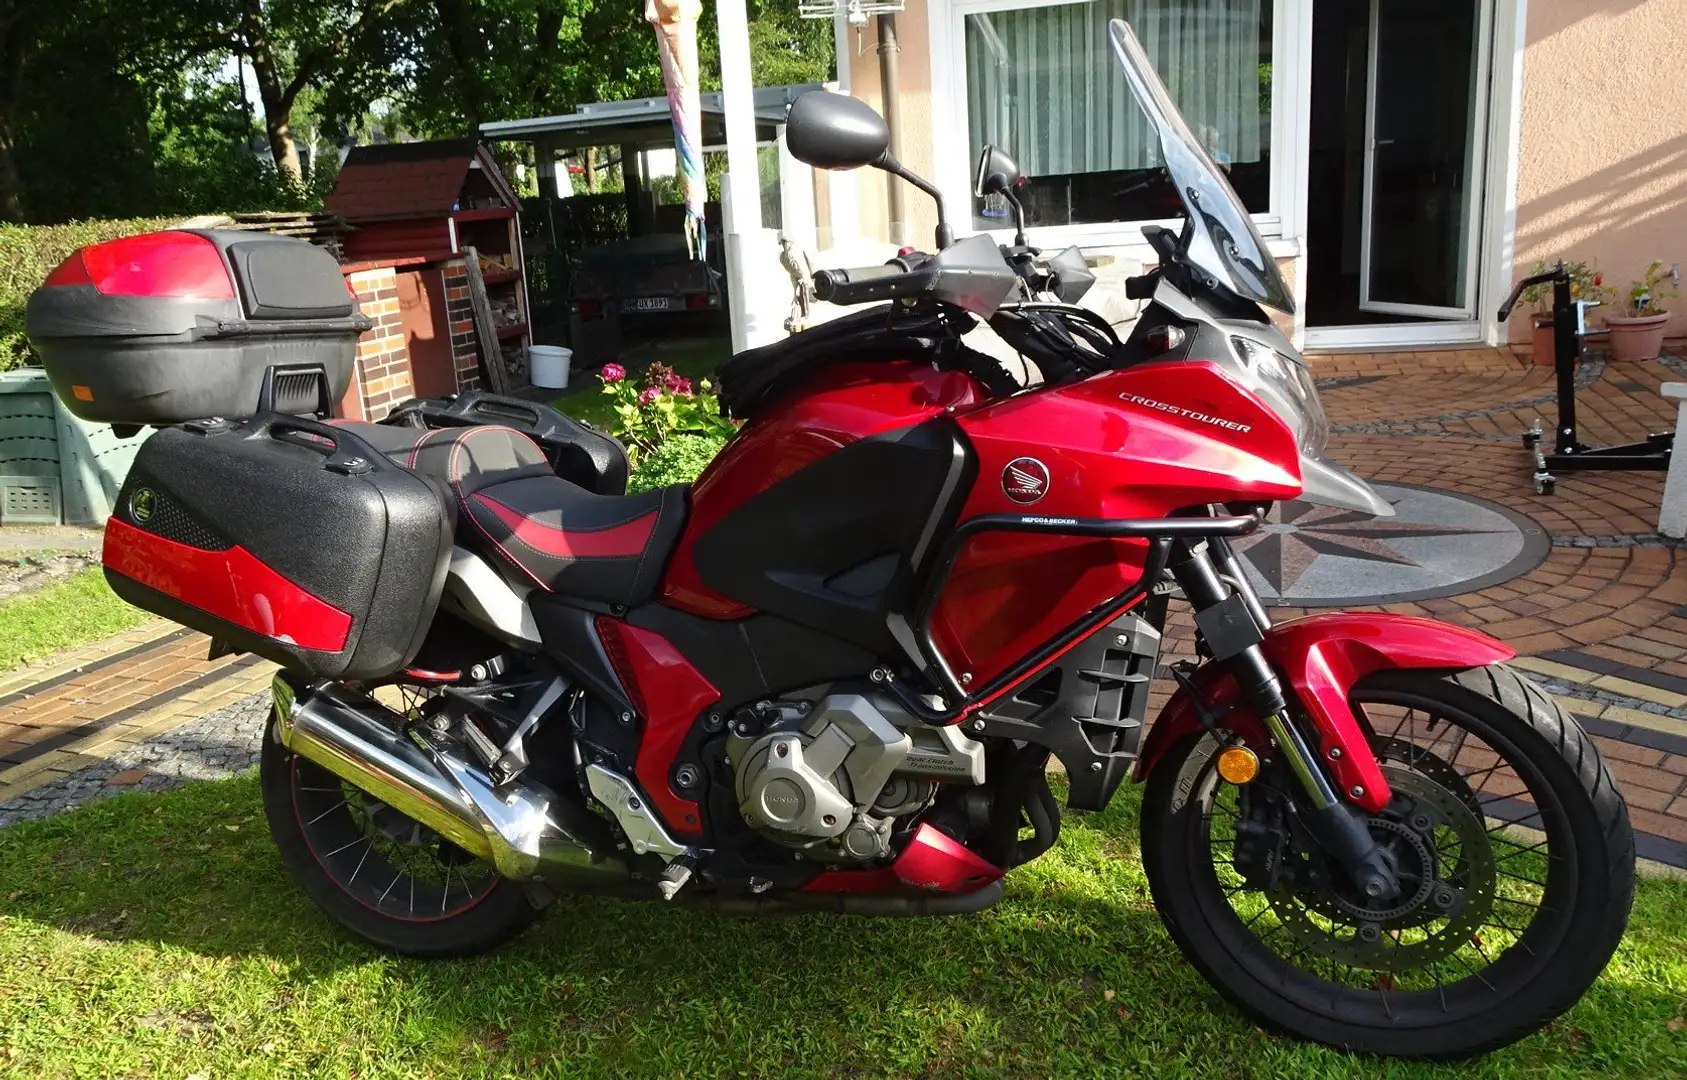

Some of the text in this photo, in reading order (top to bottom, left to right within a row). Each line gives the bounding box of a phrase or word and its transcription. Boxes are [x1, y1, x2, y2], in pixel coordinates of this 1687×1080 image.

[1118, 391, 1252, 434] CROSSTOURER
[1007, 487, 1042, 495] HONDA
[927, 757, 955, 765] Clutch
[907, 762, 966, 772] Transmission
